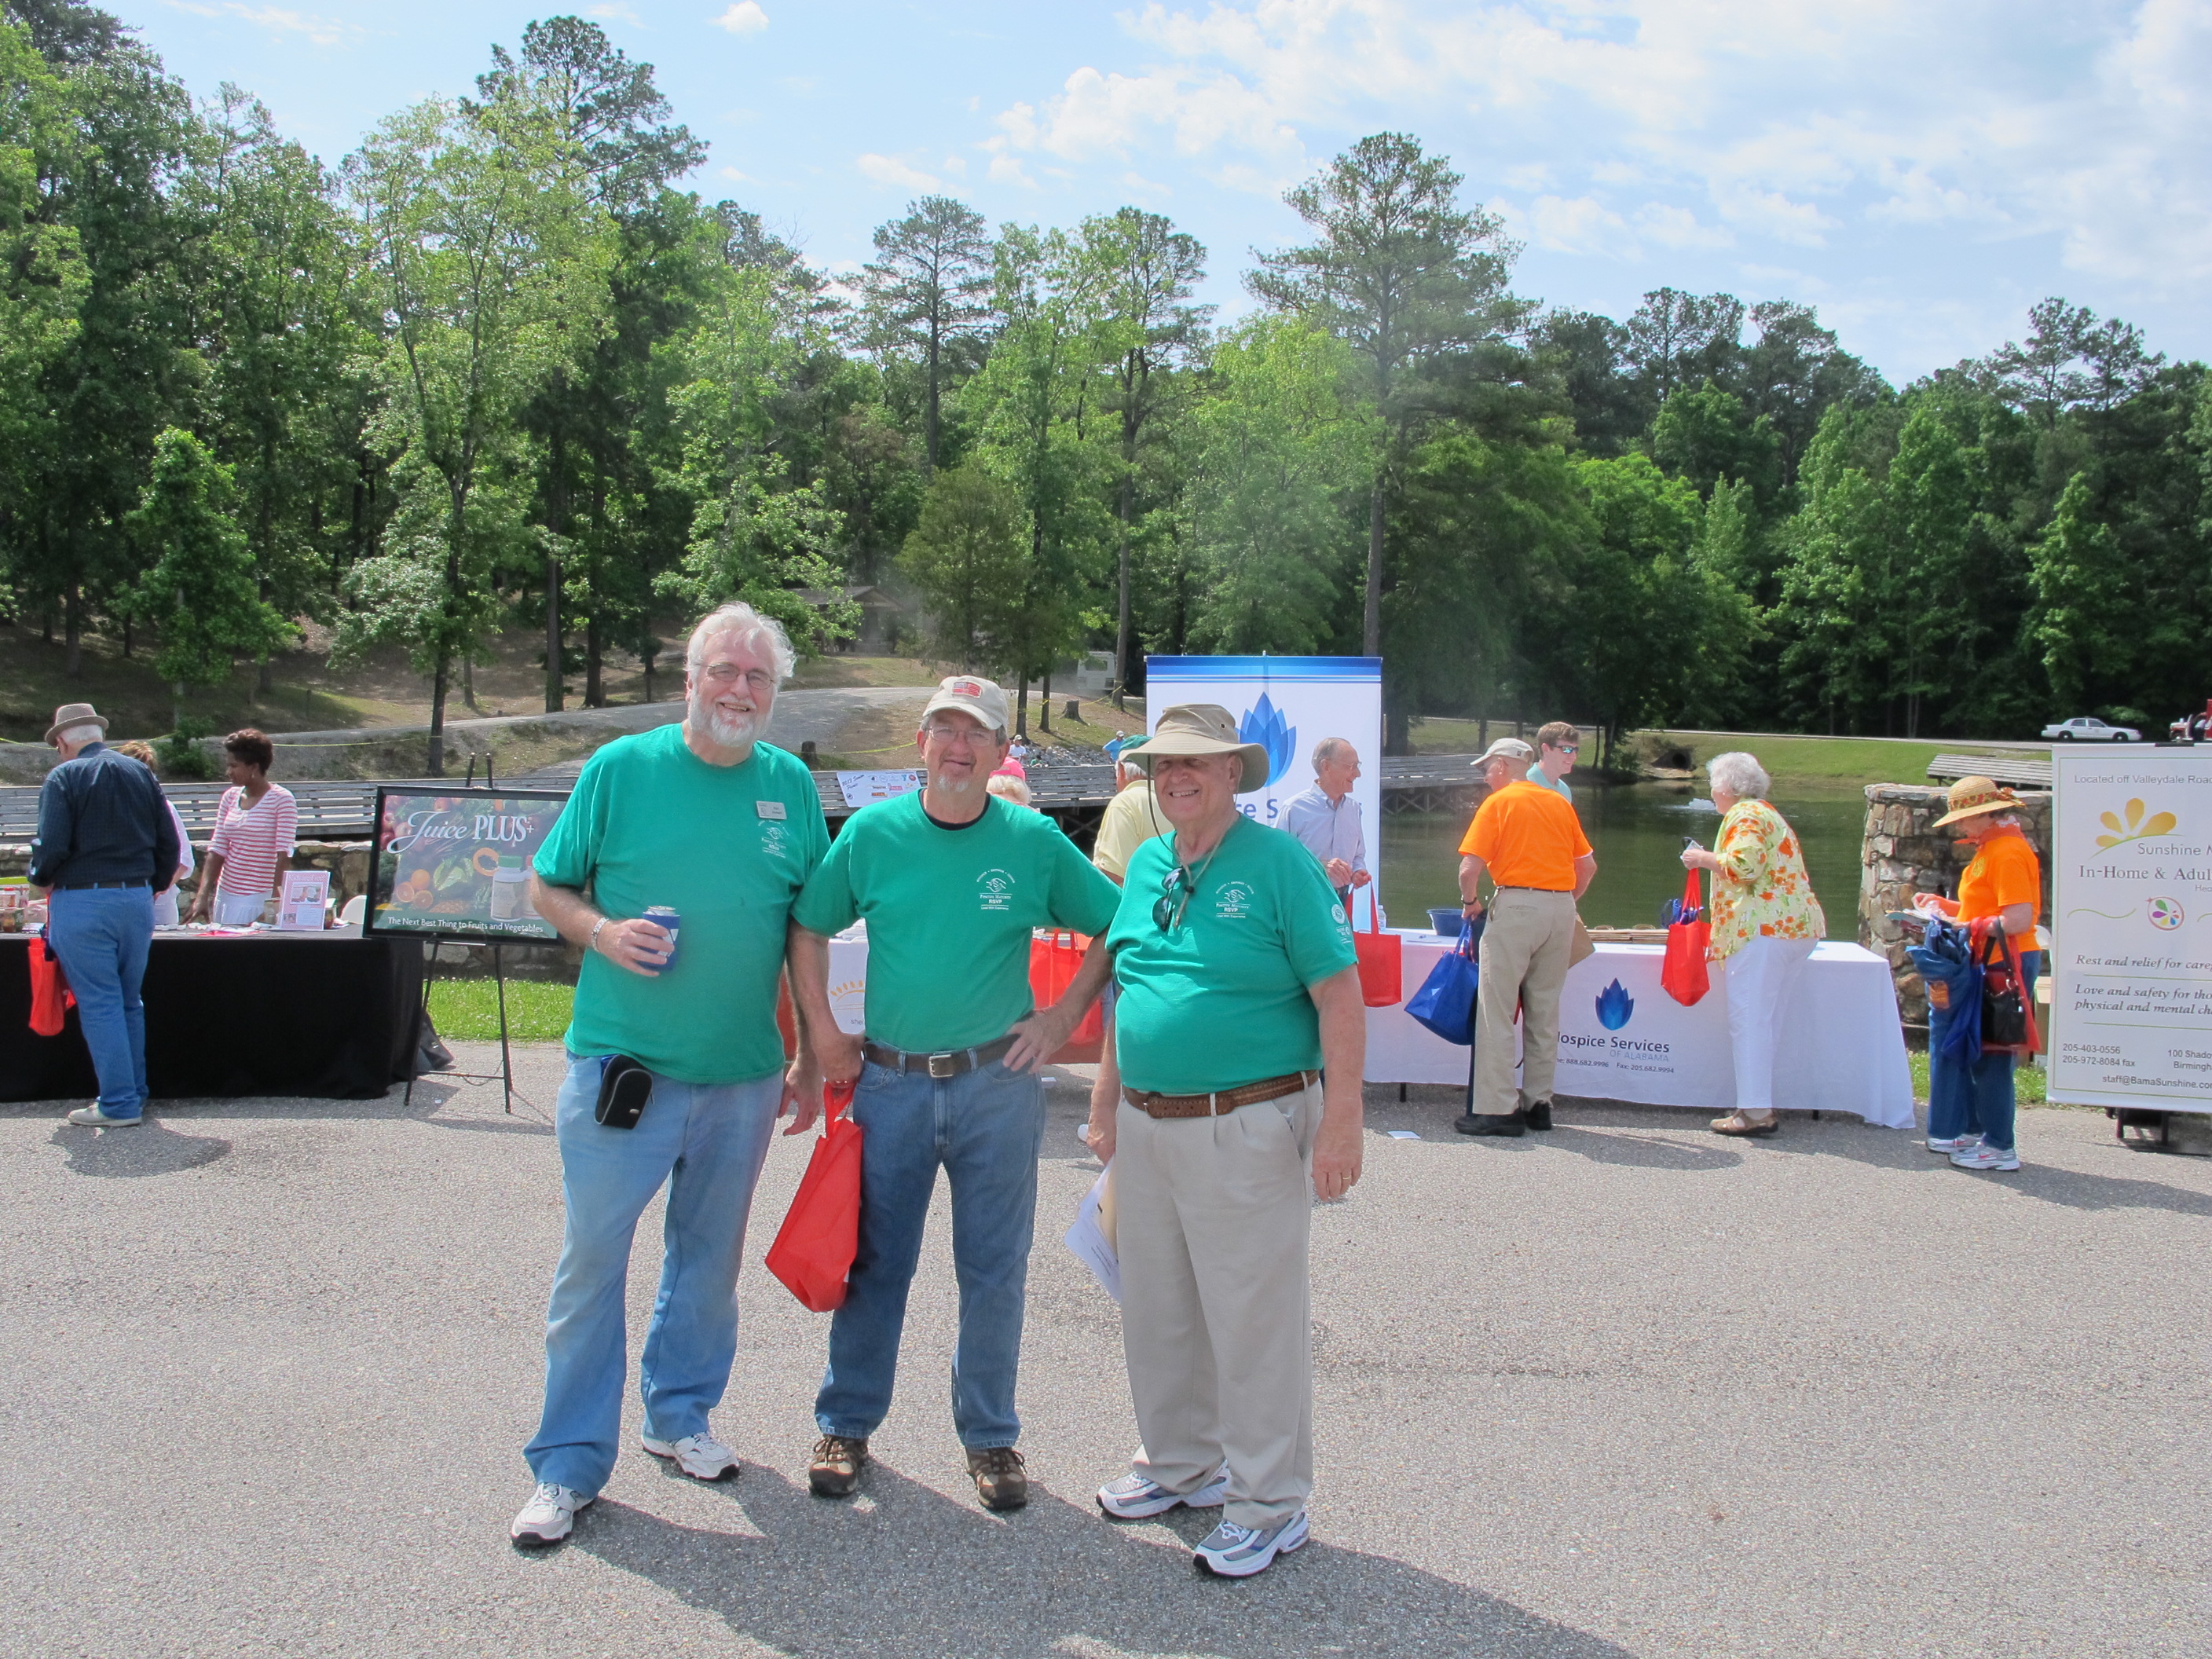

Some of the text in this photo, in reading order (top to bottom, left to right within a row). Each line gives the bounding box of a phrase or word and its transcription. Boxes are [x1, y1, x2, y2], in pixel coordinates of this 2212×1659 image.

[2074, 775, 2114, 784] Located
[2116, 775, 2130, 784] off
[2132, 775, 2185, 786] Valleydale
[386, 810, 468, 854] Juice
[2137, 842, 2202, 856] Sunshine
[2078, 865, 2212, 881] In-Home & Adul
[388, 917, 401, 925] The
[402, 917, 420, 926] Next
[438, 919, 457, 929] Thing
[468, 921, 488, 930] Fruits
[489, 922, 503, 931] and
[504, 923, 544, 933] Vegetables
[2076, 954, 2101, 965] Rest
[2104, 957, 2128, 966] and
[2131, 957, 2163, 970] relief
[2163, 958, 2182, 970] for
[2075, 984, 2104, 995] Love
[2107, 986, 2131, 996] and
[2133, 987, 2170, 1000] safety
[2171, 987, 2192, 1001] for
[2075, 999, 2212, 1015] physical and mental ch
[1558, 1031, 1670, 1053] ospice Services
[2063, 1043, 2121, 1054] 205-403-0556
[1624, 1052, 1669, 1062] ALABAMA
[2062, 1055, 2136, 1067] 205-972-8084 fax
[2167, 1049, 2212, 1059] 100 Shado
[1631, 1064, 1675, 1074] 205.682.9994
[2174, 1060, 2212, 1072] Birmingh
